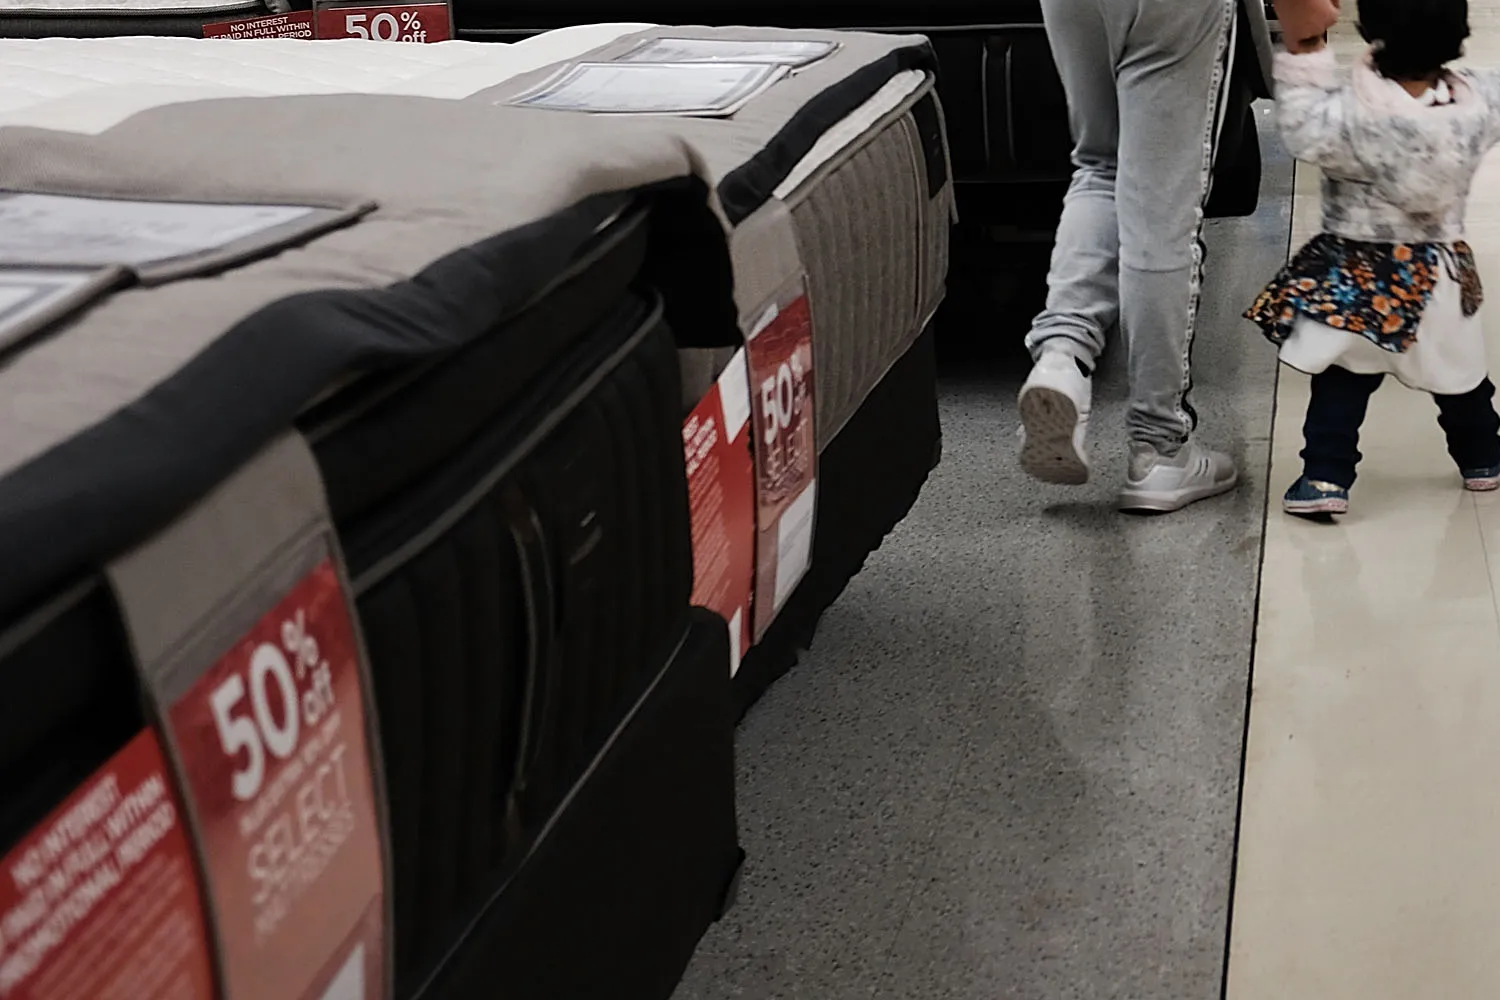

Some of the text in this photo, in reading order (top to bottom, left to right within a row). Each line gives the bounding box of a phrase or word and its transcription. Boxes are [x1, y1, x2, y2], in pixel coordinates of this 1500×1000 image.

[231, 16, 289, 33] NO INTEREST
[242, 30, 253, 39] IN
[254, 26, 276, 37] FULL
[277, 22, 310, 34] WITHIN
